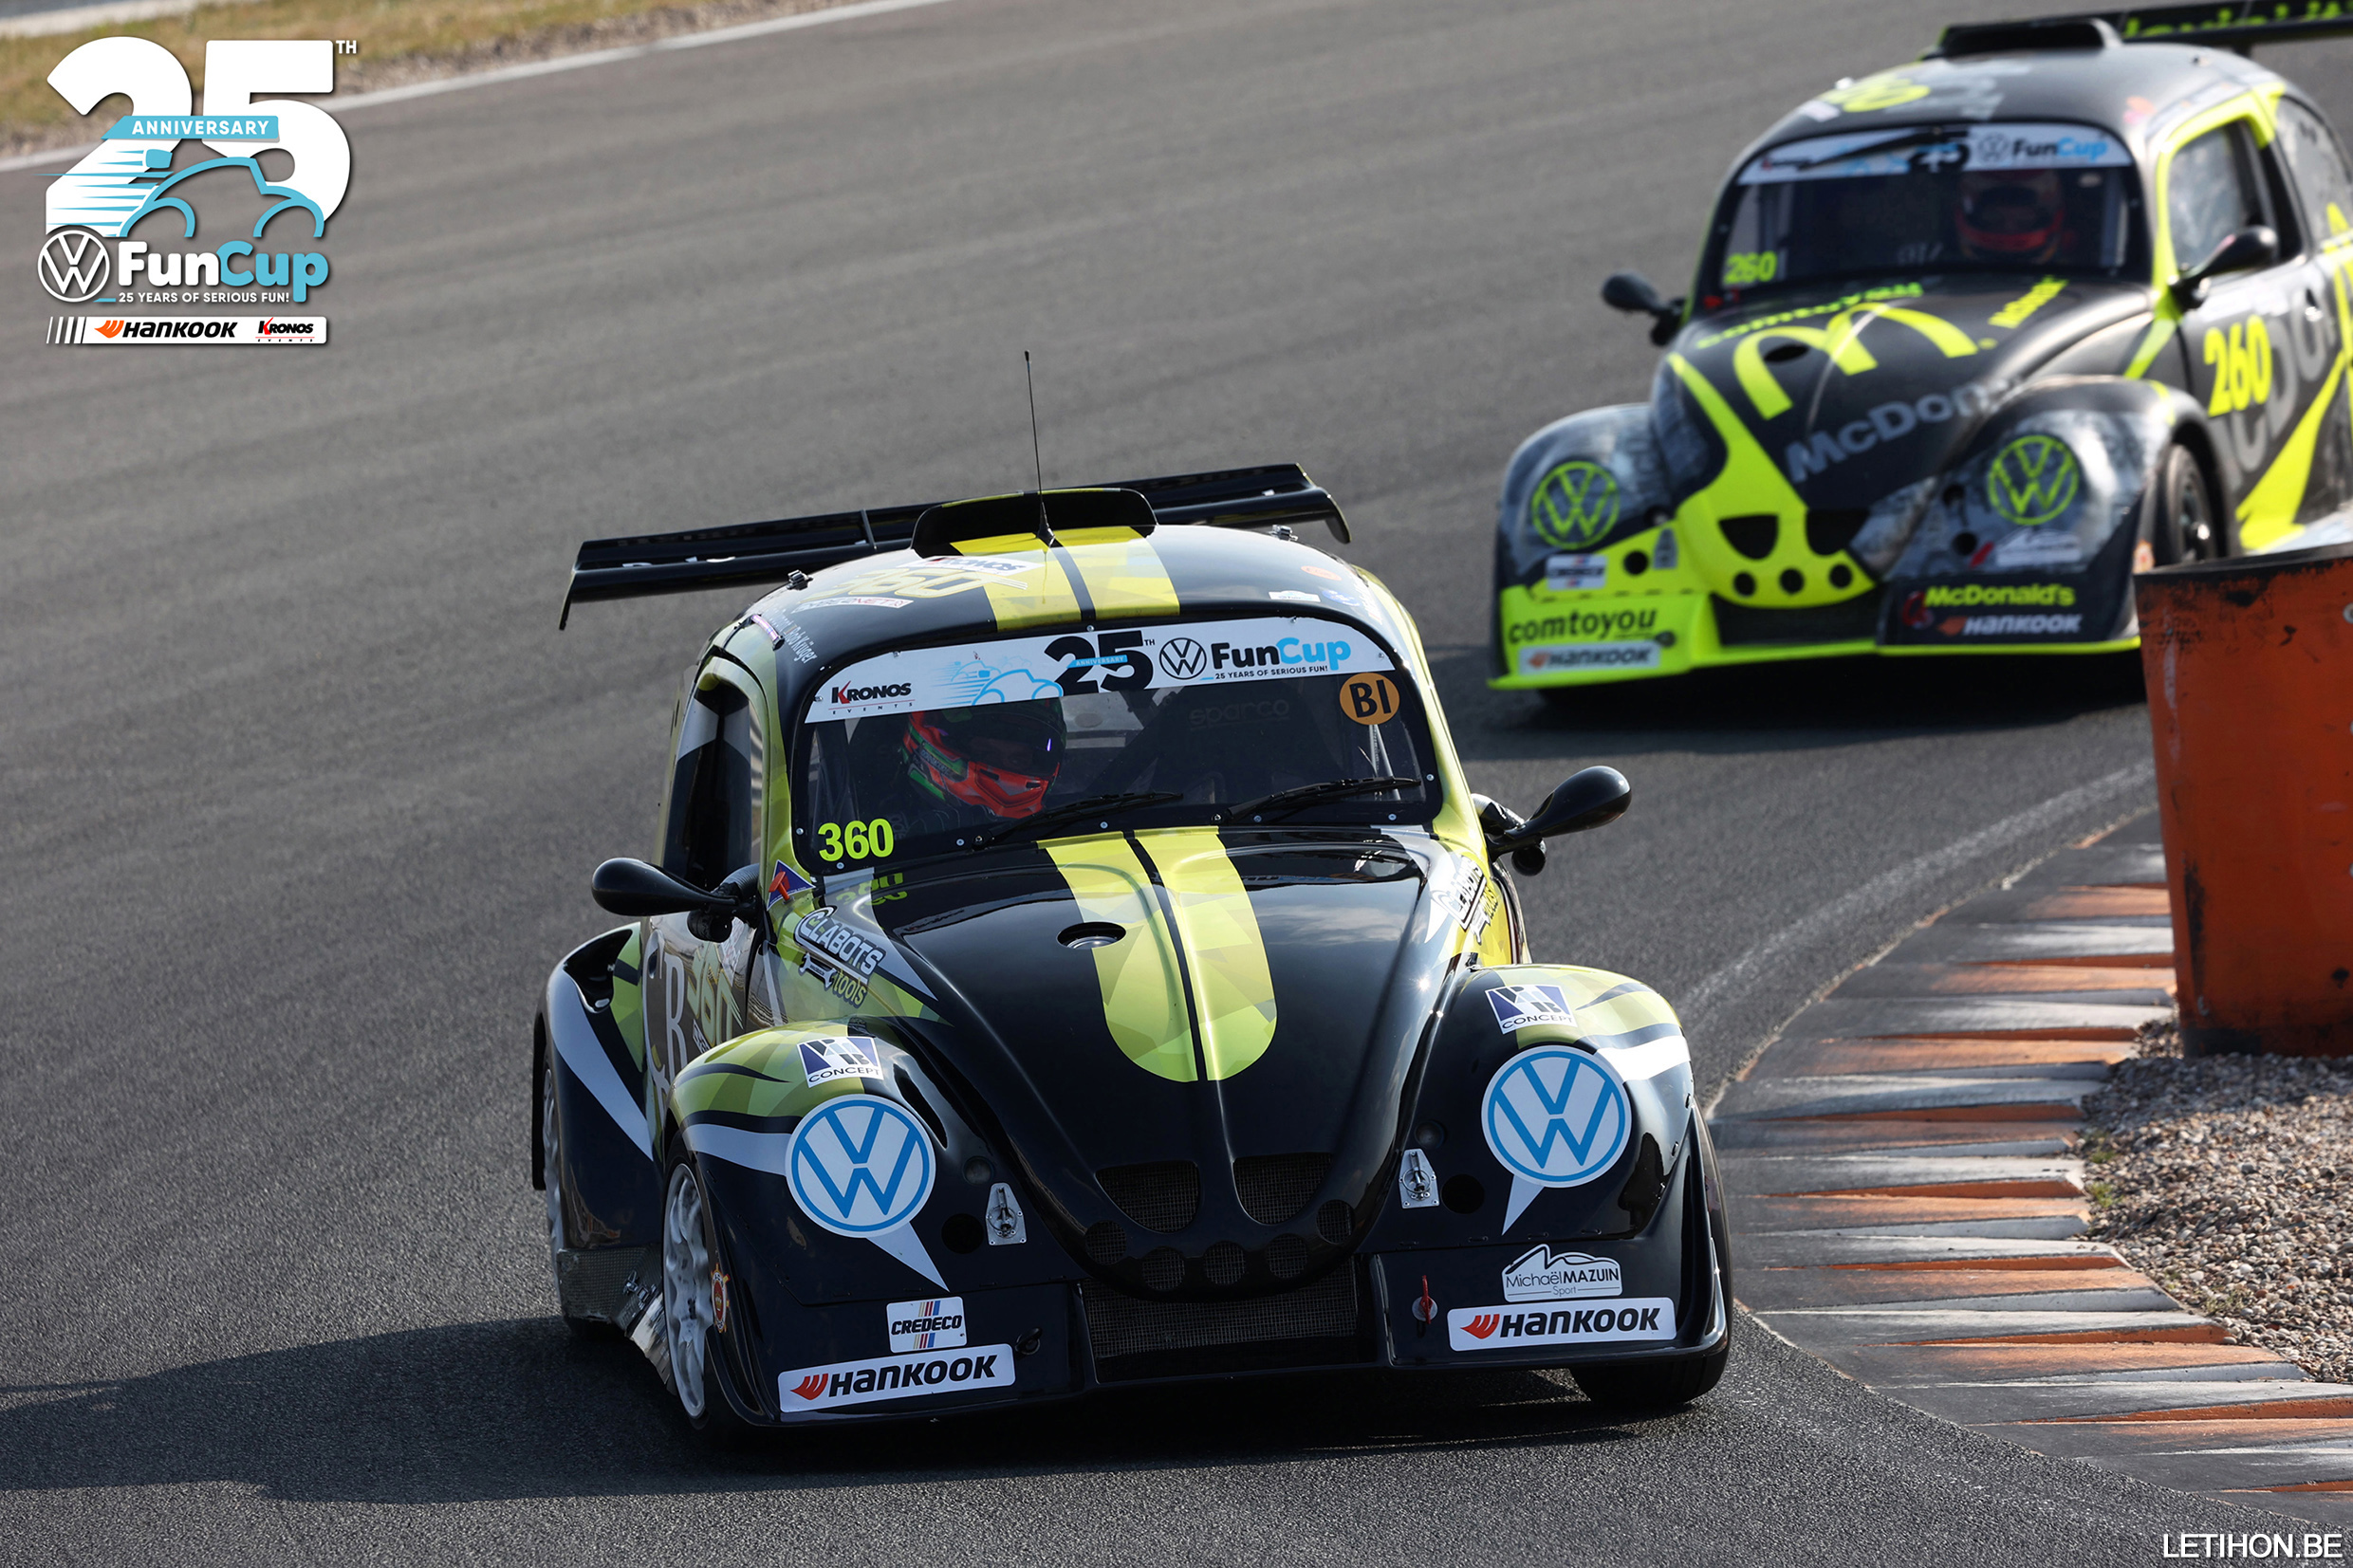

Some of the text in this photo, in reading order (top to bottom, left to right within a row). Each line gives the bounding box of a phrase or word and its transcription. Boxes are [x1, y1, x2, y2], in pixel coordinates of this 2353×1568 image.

[1724, 250, 1777, 284] 260
[2204, 315, 2272, 417] 260
[1924, 584, 2075, 607] McDonald's
[1509, 609, 1657, 645] comtoyou
[1044, 630, 1154, 693] 25
[1211, 637, 1351, 671] FunCup
[1271, 667, 1306, 675] SERIOUS
[831, 680, 911, 704] KRONOS
[818, 818, 894, 861] 360
[800, 913, 884, 975] CLABOTS
[832, 968, 867, 1005] tools
[1502, 1014, 1574, 1029] CONCEPT
[808, 1066, 880, 1083] CONCEPT
[1506, 1267, 1620, 1288] Michaël MAZUIN
[1552, 1284, 1577, 1297] Sport
[891, 1315, 962, 1336] CREDECO
